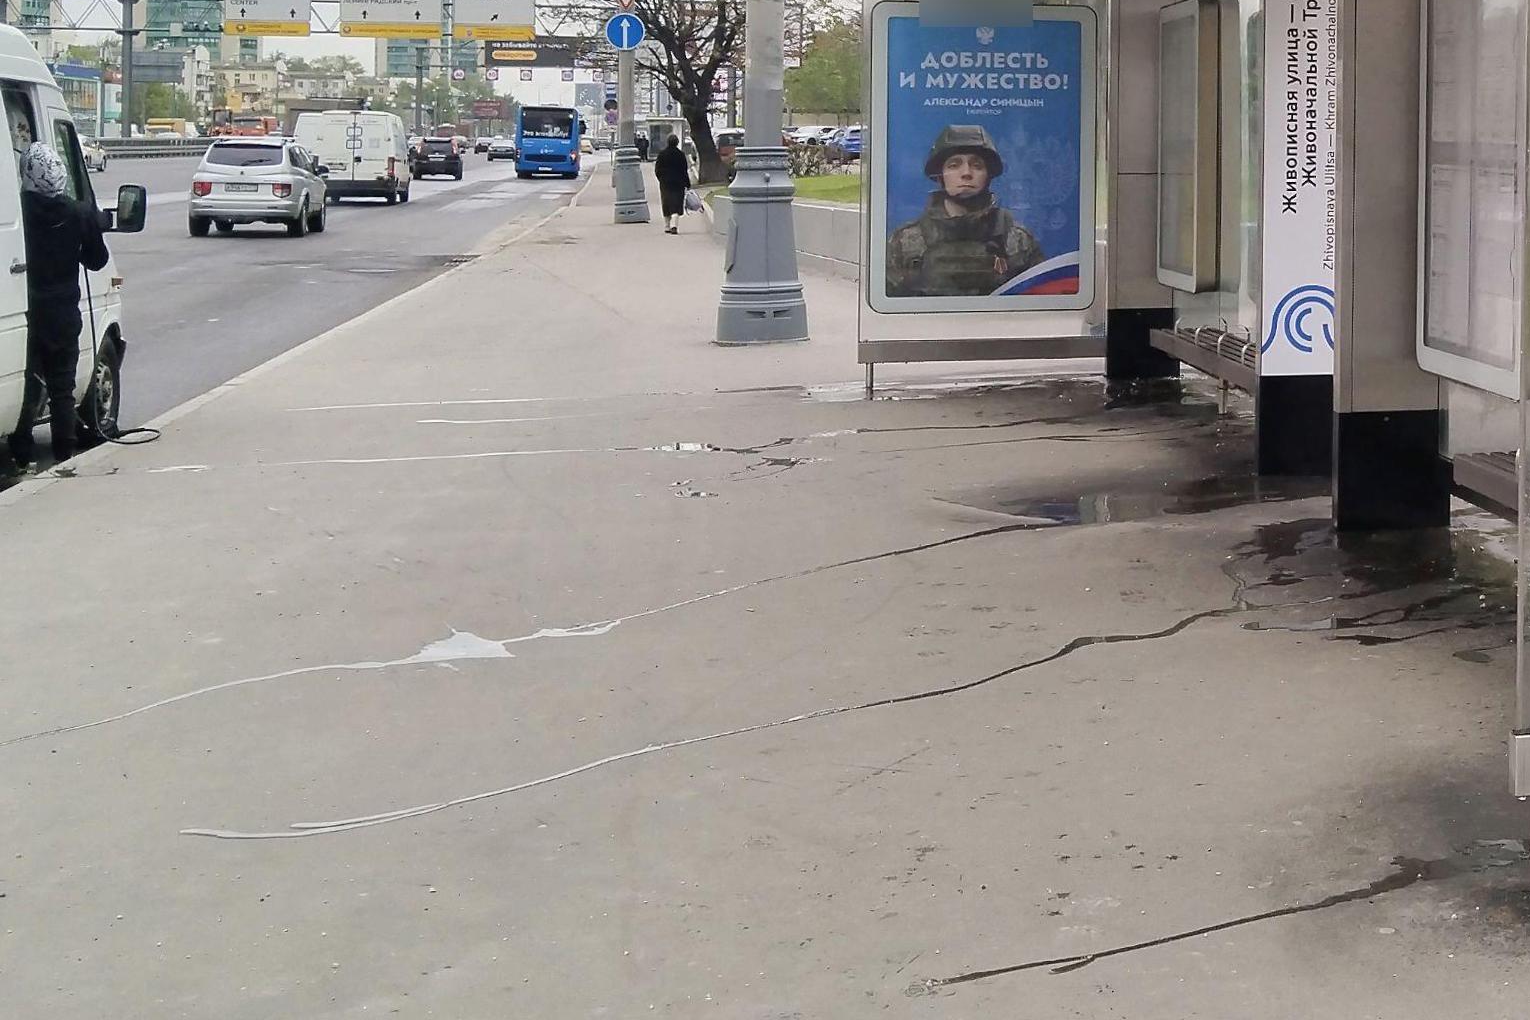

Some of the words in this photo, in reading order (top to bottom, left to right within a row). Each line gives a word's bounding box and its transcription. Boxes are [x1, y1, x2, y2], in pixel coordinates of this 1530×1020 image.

[920, 51, 1049, 69] ДОБЛЕСТЬ
[1286, 28, 1302, 86] улица
[899, 72, 916, 88] И
[925, 73, 1068, 90] МУЖЕСТВО!
[923, 97, 988, 107] АЛЕКСАНДР
[990, 98, 1044, 107] СИНИЦЫН
[1301, 28, 1320, 188] Живоначальной
[1324, 90, 1336, 130] Khram
[1281, 90, 1300, 214] Живописная
[1324, 150, 1336, 186] Ulitsa
[1323, 188, 1337, 270] Zhivopisnaya
